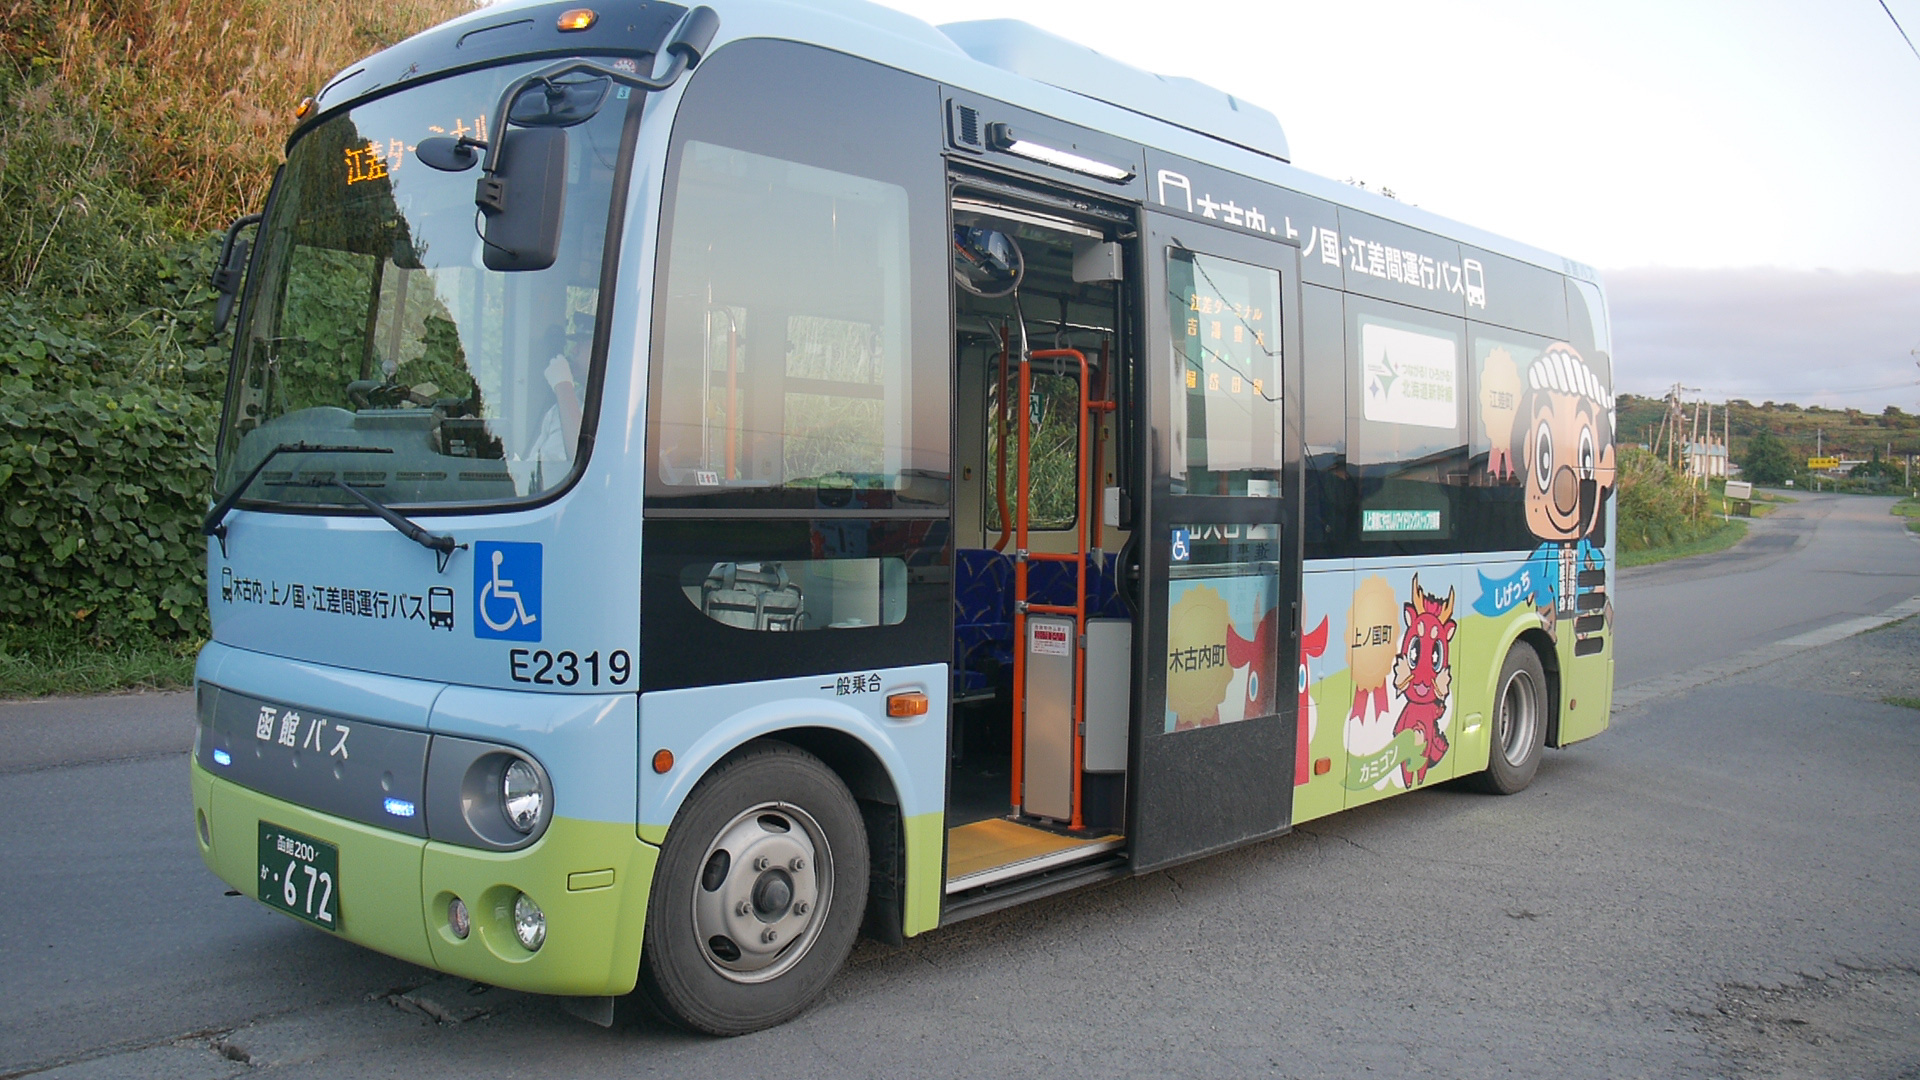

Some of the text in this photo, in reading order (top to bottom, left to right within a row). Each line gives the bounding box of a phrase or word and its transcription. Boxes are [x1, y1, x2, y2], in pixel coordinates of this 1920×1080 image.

[1495, 570, 1531, 609] しげっち
[1351, 625, 1392, 648] 上ノ国町
[510, 649, 631, 686] E2319
[1169, 644, 1226, 673] 木古内町
[820, 673, 882, 695] 一般乗合
[256, 706, 351, 760] 函館バス
[1359, 745, 1399, 783] カミゴン
